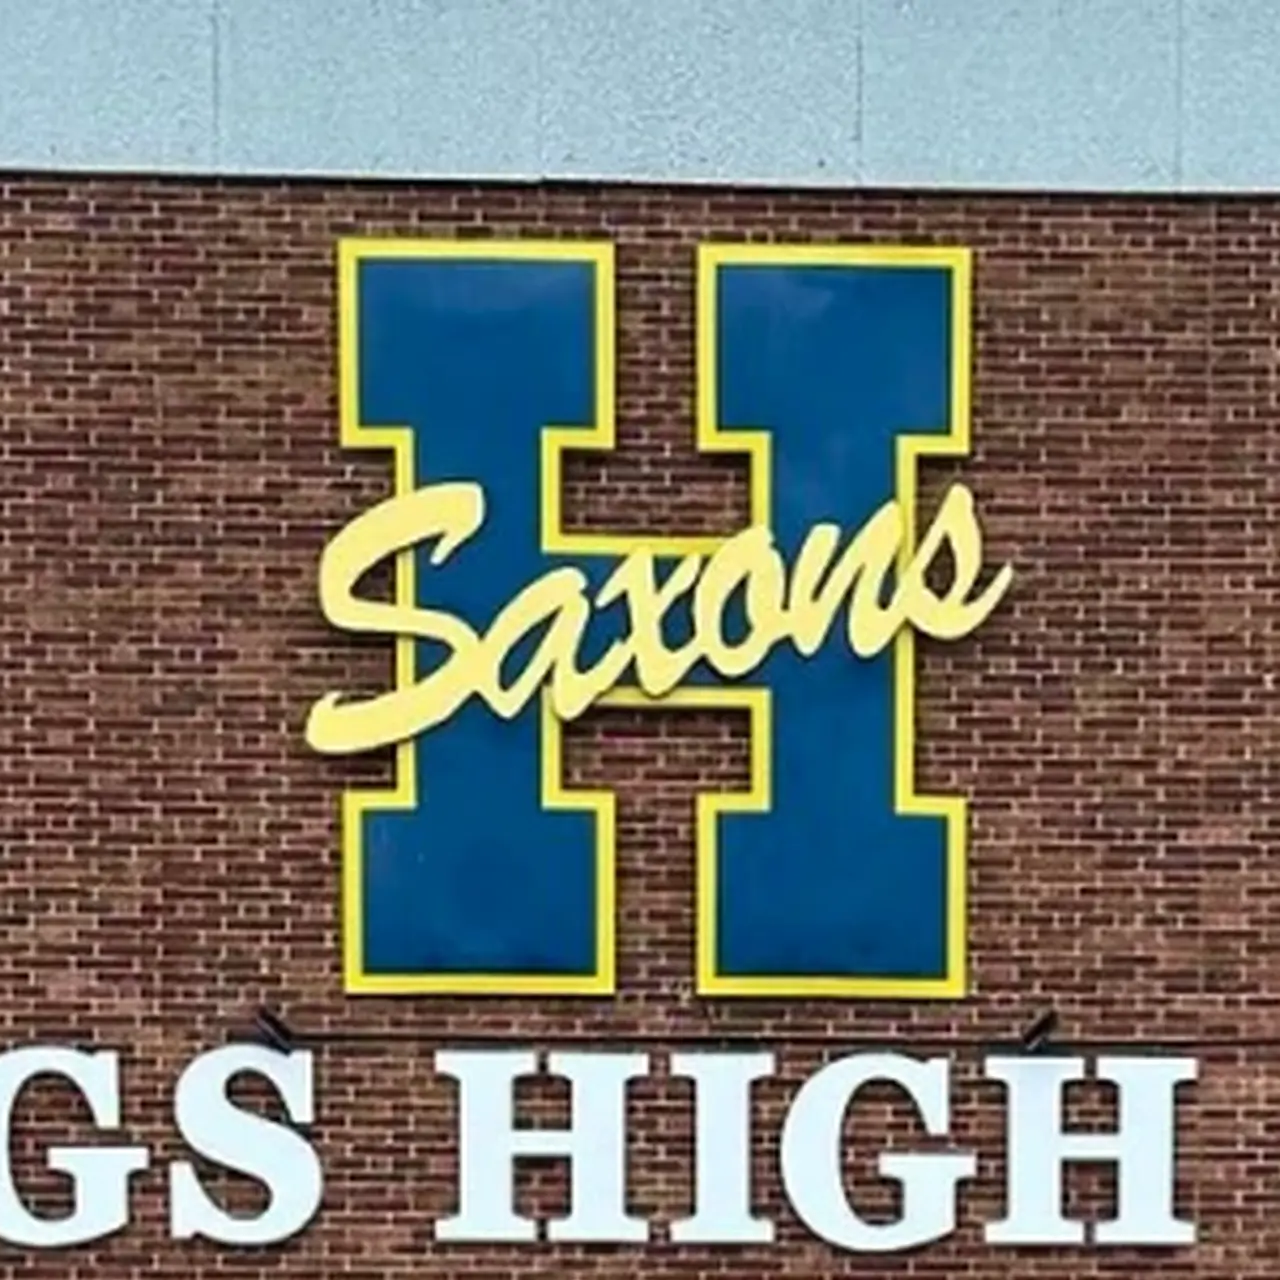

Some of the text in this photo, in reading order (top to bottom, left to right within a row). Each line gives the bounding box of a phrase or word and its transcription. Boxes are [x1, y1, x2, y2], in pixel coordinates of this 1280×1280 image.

[305, 481, 1014, 755] Saxons
[338, 239, 972, 997] H
[435, 1051, 1198, 1251] HIGH
